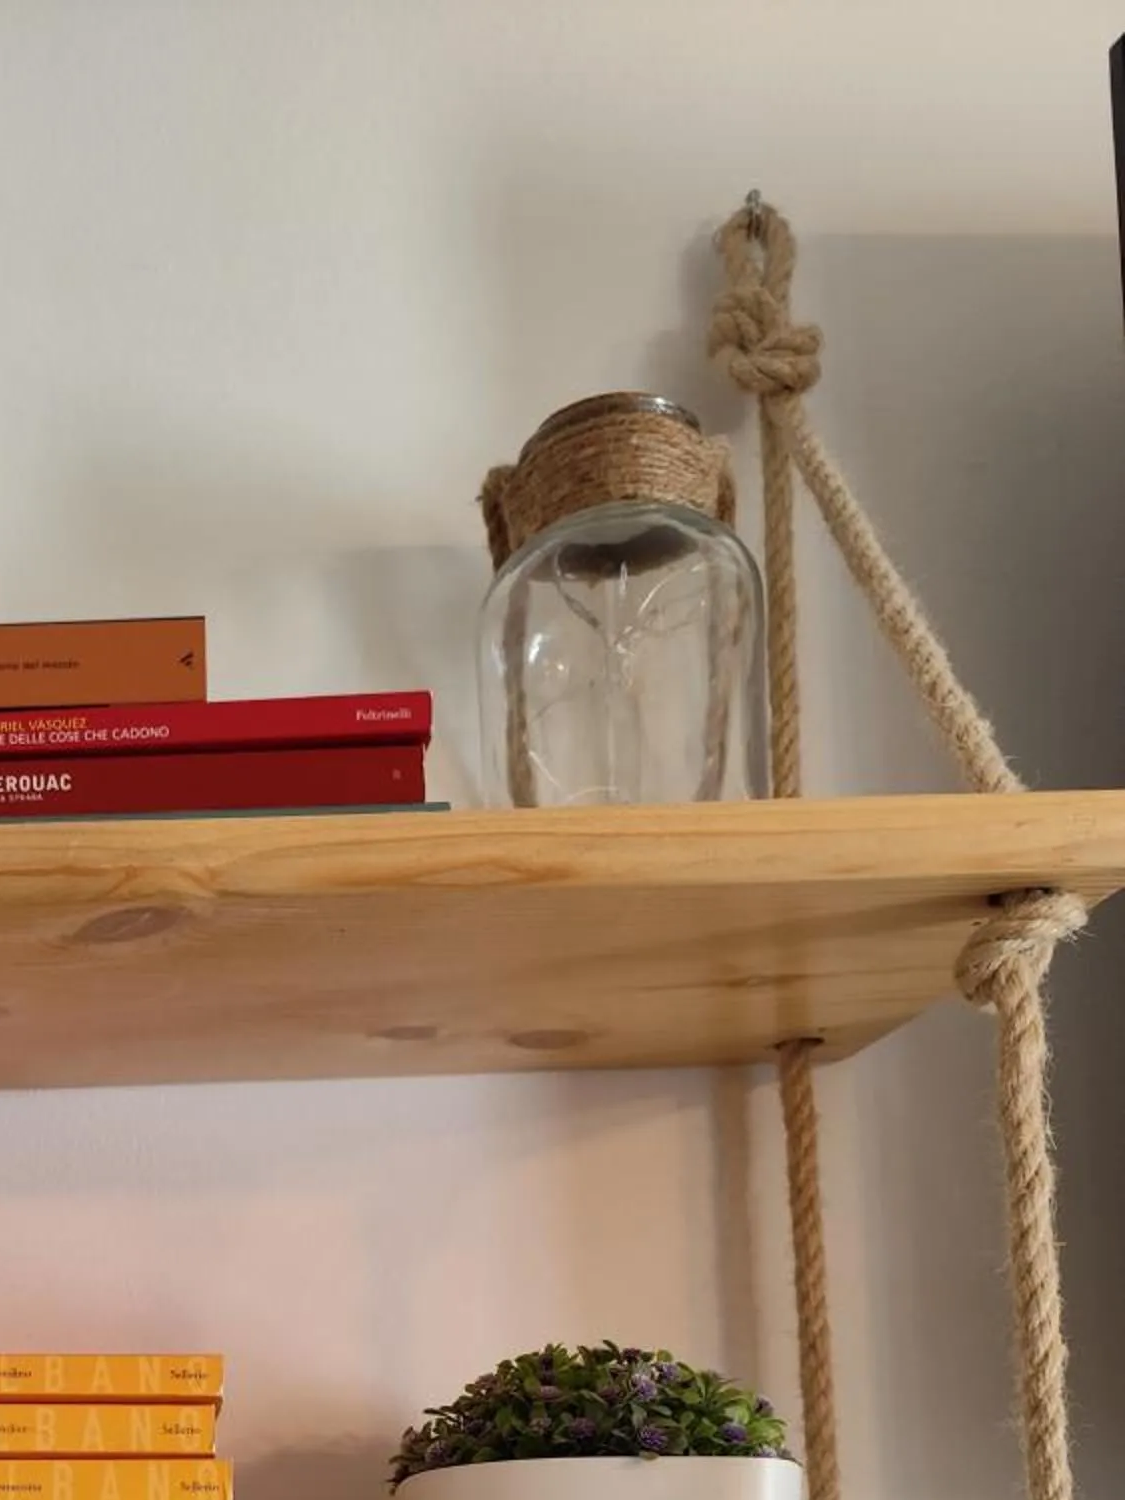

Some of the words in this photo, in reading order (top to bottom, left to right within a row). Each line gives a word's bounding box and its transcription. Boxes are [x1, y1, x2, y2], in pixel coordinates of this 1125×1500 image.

[9, 732, 46, 745] DELLE
[49, 730, 82, 743] COSE
[84, 729, 108, 742] CHE
[112, 726, 170, 741] CADONO
